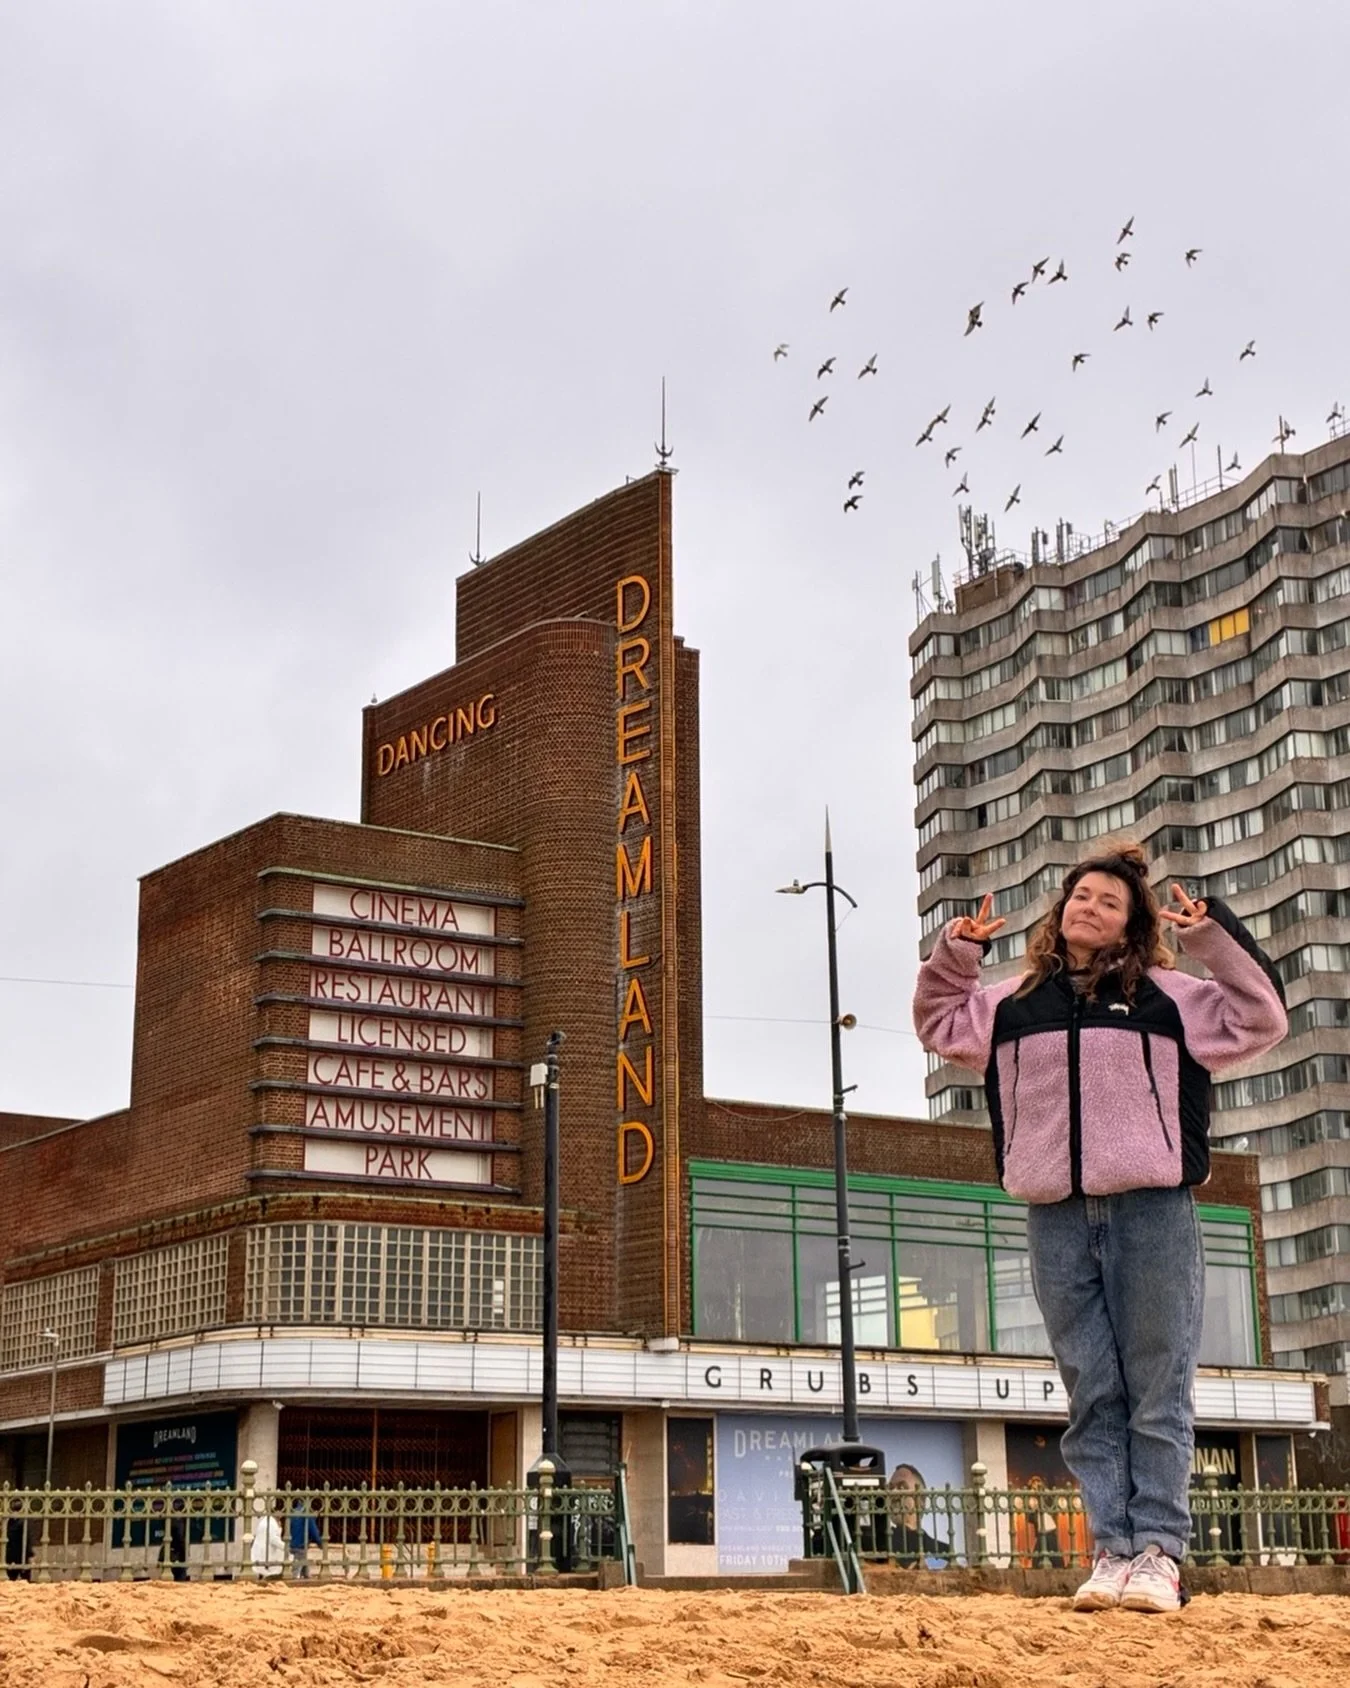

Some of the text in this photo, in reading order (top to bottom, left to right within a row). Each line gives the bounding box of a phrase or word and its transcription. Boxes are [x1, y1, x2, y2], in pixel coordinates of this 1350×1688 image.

[377, 693, 496, 777] DANCING
[616, 575, 652, 1184] DREAMLAND
[349, 890, 460, 932] CINEMA
[328, 929, 480, 974] BALLROOM
[313, 971, 492, 1015] RESTAURANT
[337, 1014, 467, 1055] LICENSED
[312, 1051, 488, 1101] CAFE & BARS
[309, 1098, 492, 1141] AMUSEMENT
[365, 1147, 432, 1180] PARK
[704, 1366, 1055, 1401] GRUBS UP
[153, 1426, 197, 1448] DREAMLAND
[1190, 1447, 1236, 1474] NAN
[719, 1555, 758, 1565] FRIDAY
